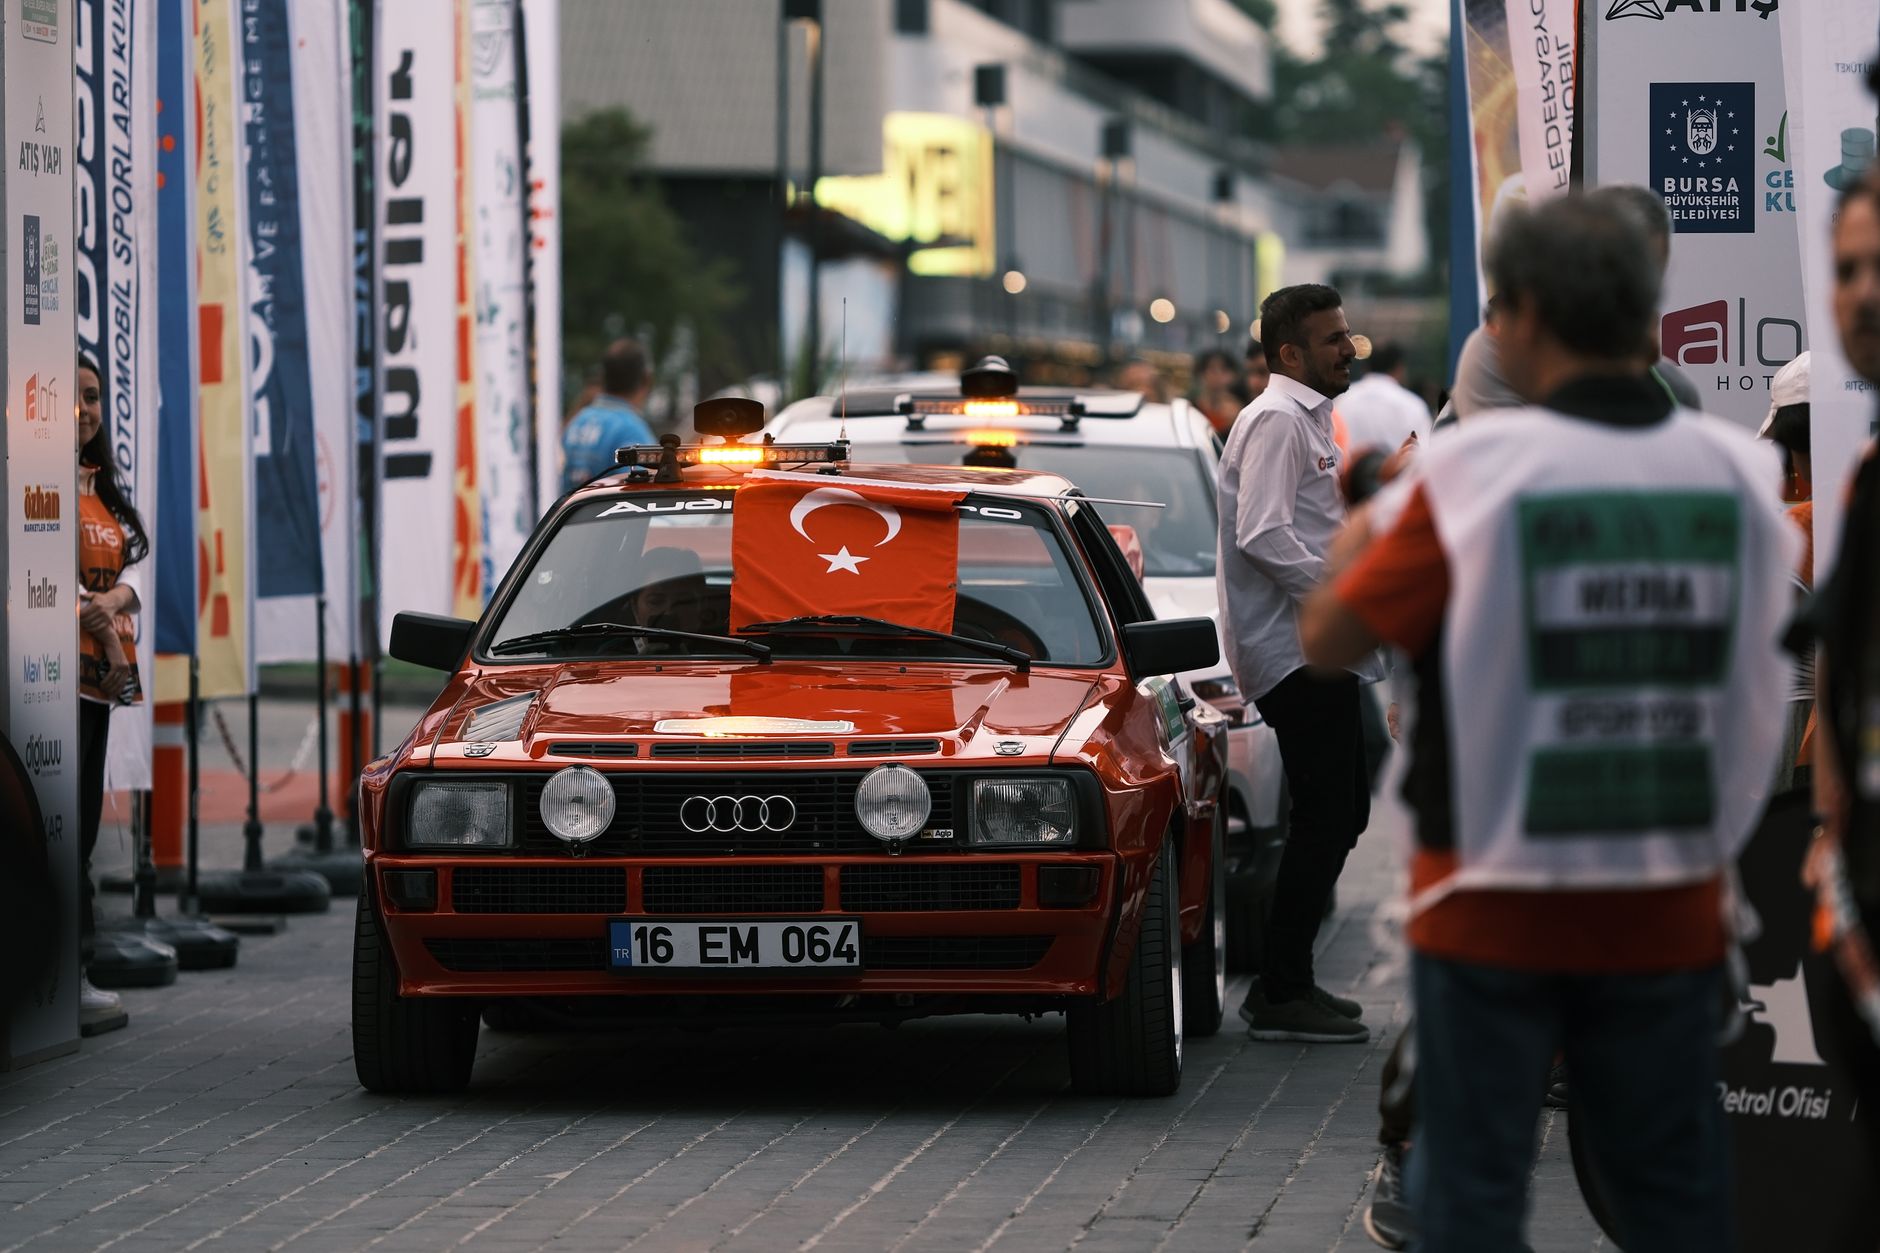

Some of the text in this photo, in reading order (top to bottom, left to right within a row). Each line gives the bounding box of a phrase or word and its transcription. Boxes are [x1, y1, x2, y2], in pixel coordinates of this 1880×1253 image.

[19, 141, 62, 177] ATIŞ YAPI
[112, 69, 132, 266] SPORLARI
[1664, 177, 1739, 193] BURSA
[1664, 193, 1739, 209] BÜYÜKŞEHİR
[1671, 207, 1740, 220] ELEDİYESİ
[111, 278, 131, 472] OTOMOBİL
[26, 372, 57, 422] aloft
[24, 485, 60, 521] özhan
[27, 569, 58, 609] İnallar
[23, 652, 61, 685] Mavi Yeşil
[614, 948, 630, 959] TR
[634, 924, 857, 965] 16 EM 064
[1778, 1086, 1832, 1120] Ofisi
